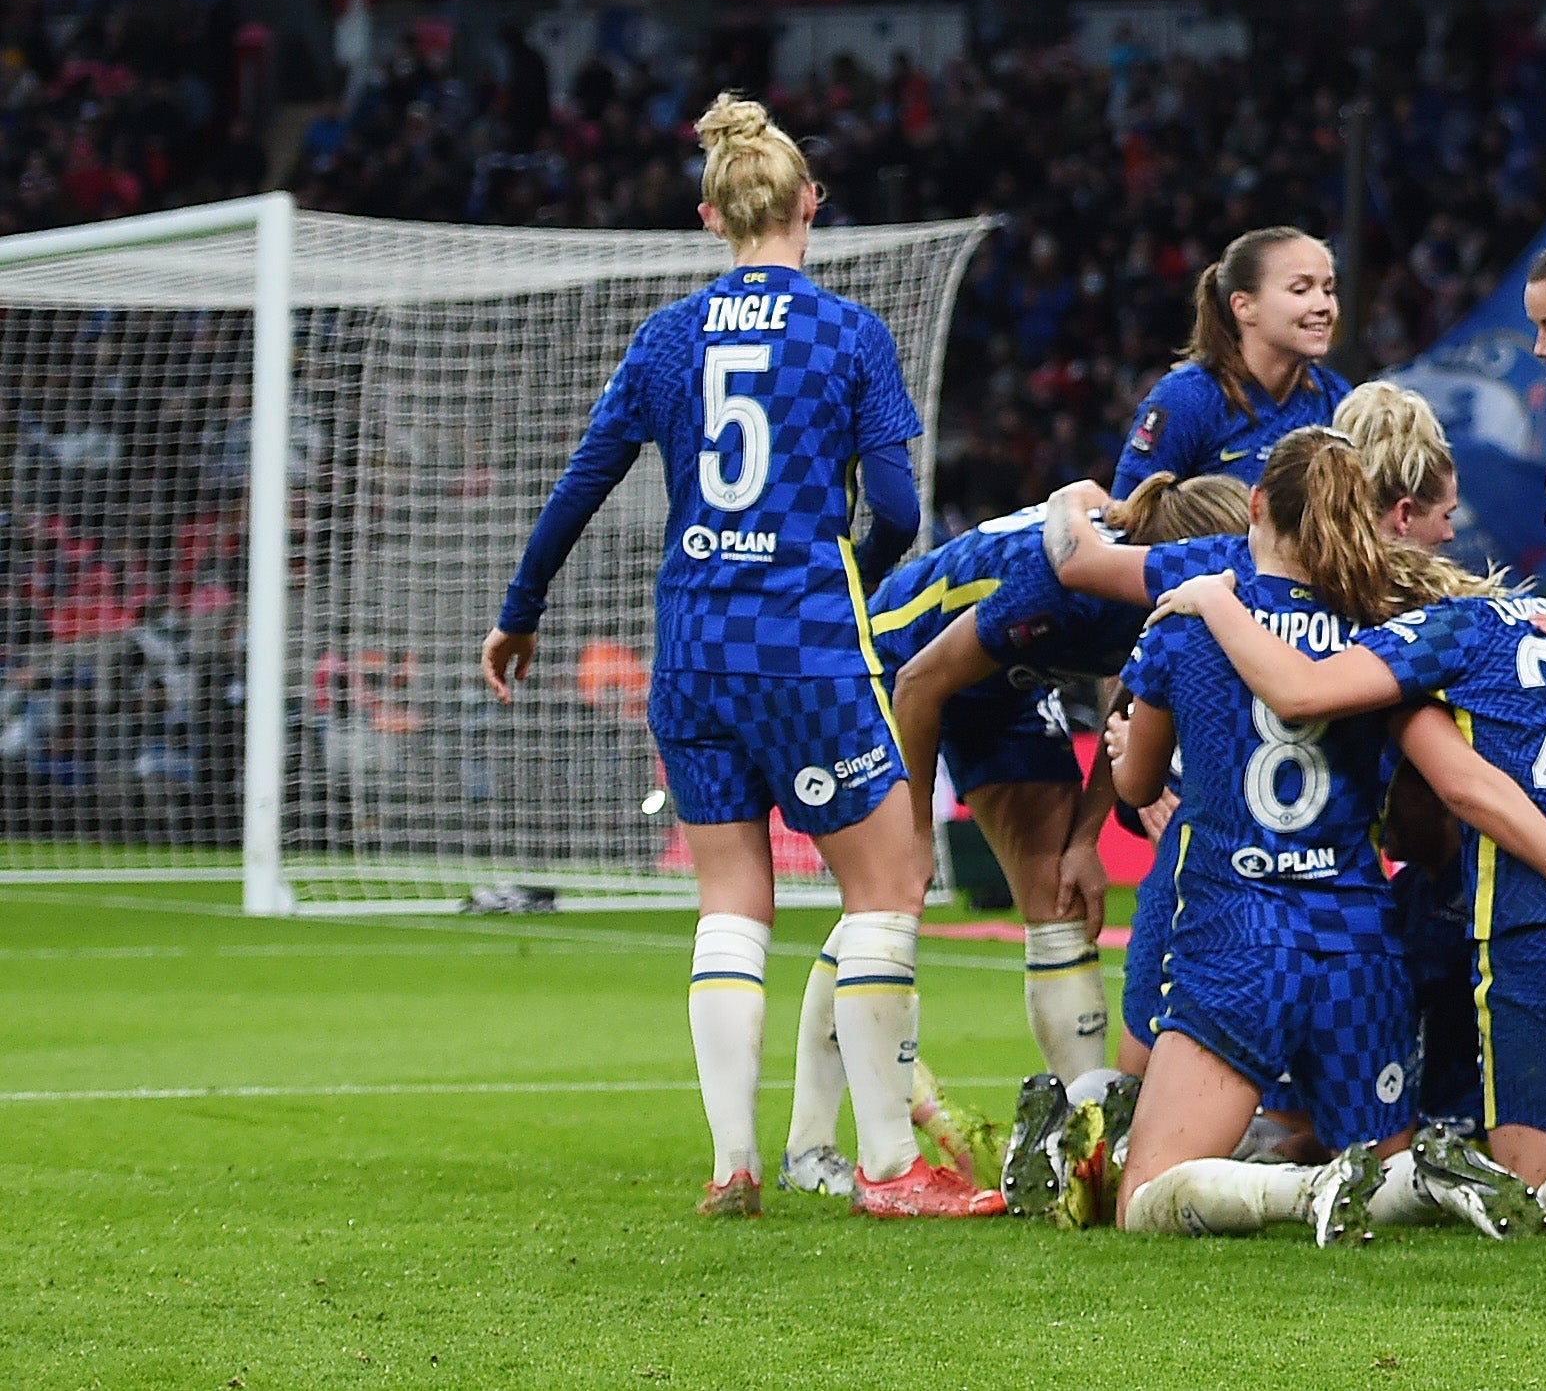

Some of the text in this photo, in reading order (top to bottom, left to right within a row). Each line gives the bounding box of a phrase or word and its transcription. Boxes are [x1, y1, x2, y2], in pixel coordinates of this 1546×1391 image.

[703, 295, 793, 331] INGLE
[700, 345, 770, 511] 5
[721, 530, 776, 553] PLAN
[834, 744, 886, 779] Singer
[1244, 693, 1331, 833] 8
[1277, 847, 1335, 873] PLAN
